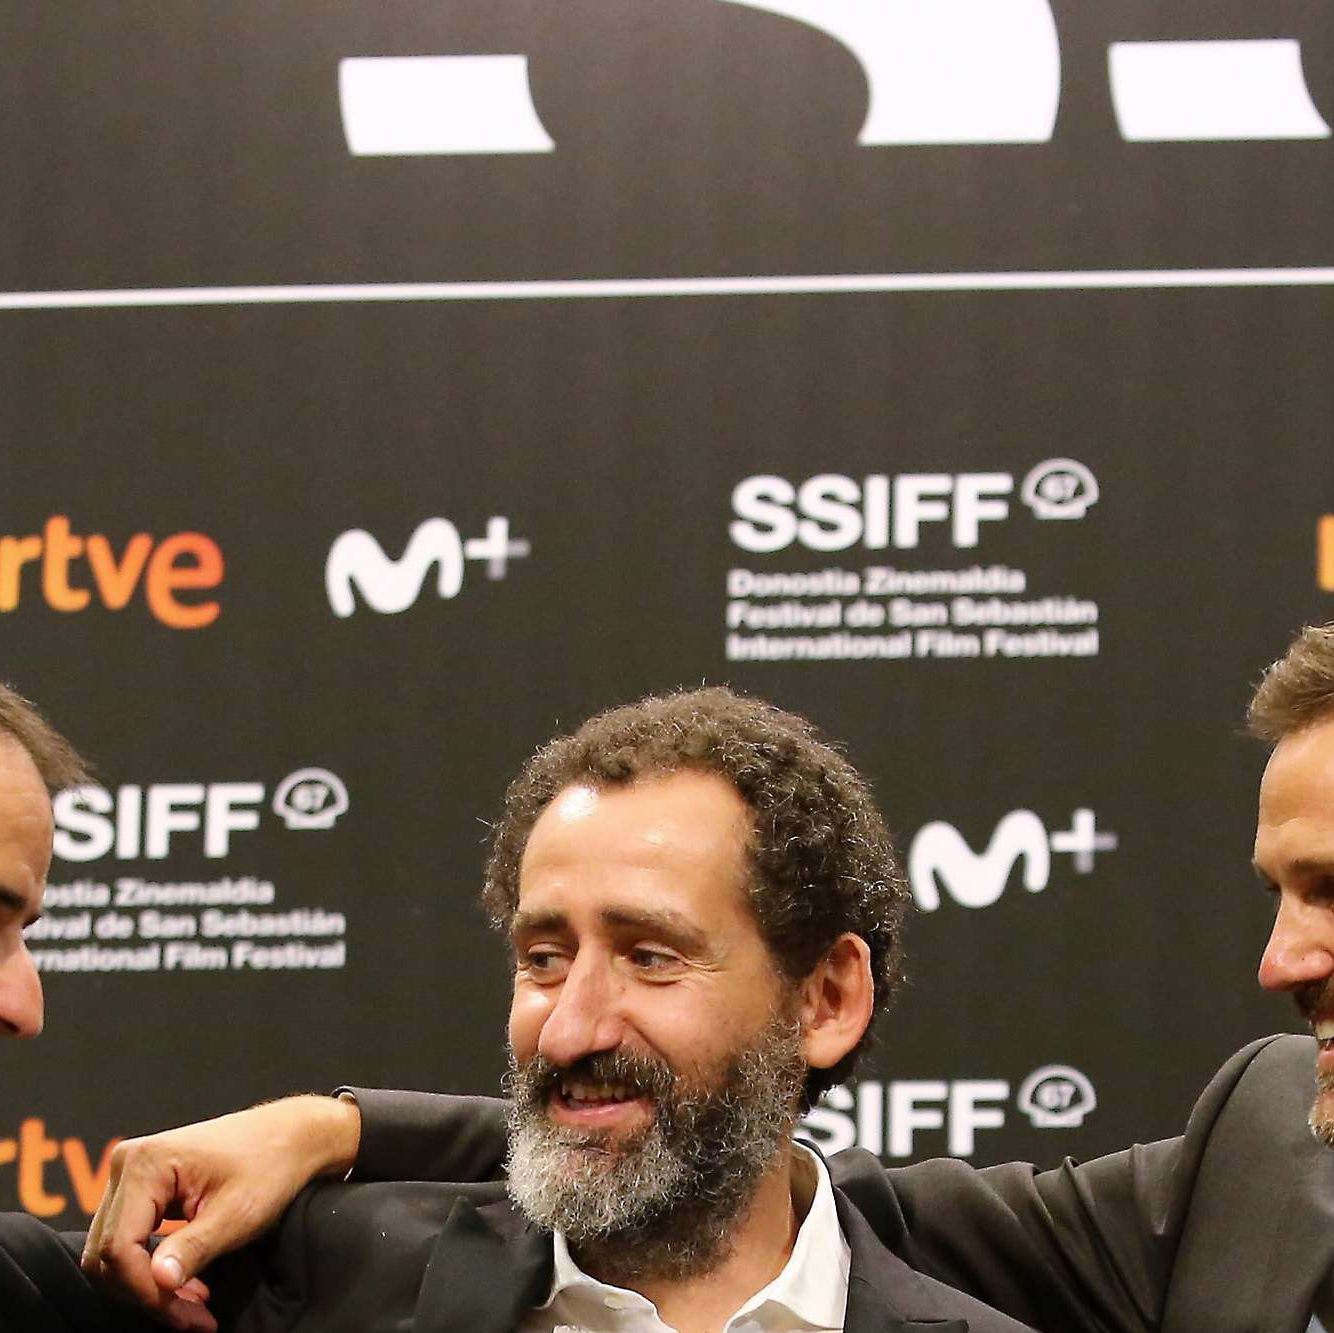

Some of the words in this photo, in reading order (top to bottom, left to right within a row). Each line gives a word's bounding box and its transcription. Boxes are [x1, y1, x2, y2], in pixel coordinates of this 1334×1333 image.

[729, 473, 1014, 553] SSIFF
[726, 568, 860, 597] Donostia
[864, 565, 1026, 595] Zinemaldia
[726, 600, 841, 628] Festival
[845, 600, 885, 627] de
[890, 599, 949, 626] San
[726, 632, 913, 659] International
[915, 631, 981, 657] Film
[984, 629, 1099, 656] Festival
[52, 783, 266, 862] SIFF
[114, 877, 275, 906] Zinemaldia
[94, 912, 134, 939] de
[139, 910, 197, 938] San
[165, 944, 228, 971] Film
[233, 940, 345, 969] Festival
[793, 1080, 1009, 1157] SIFF
